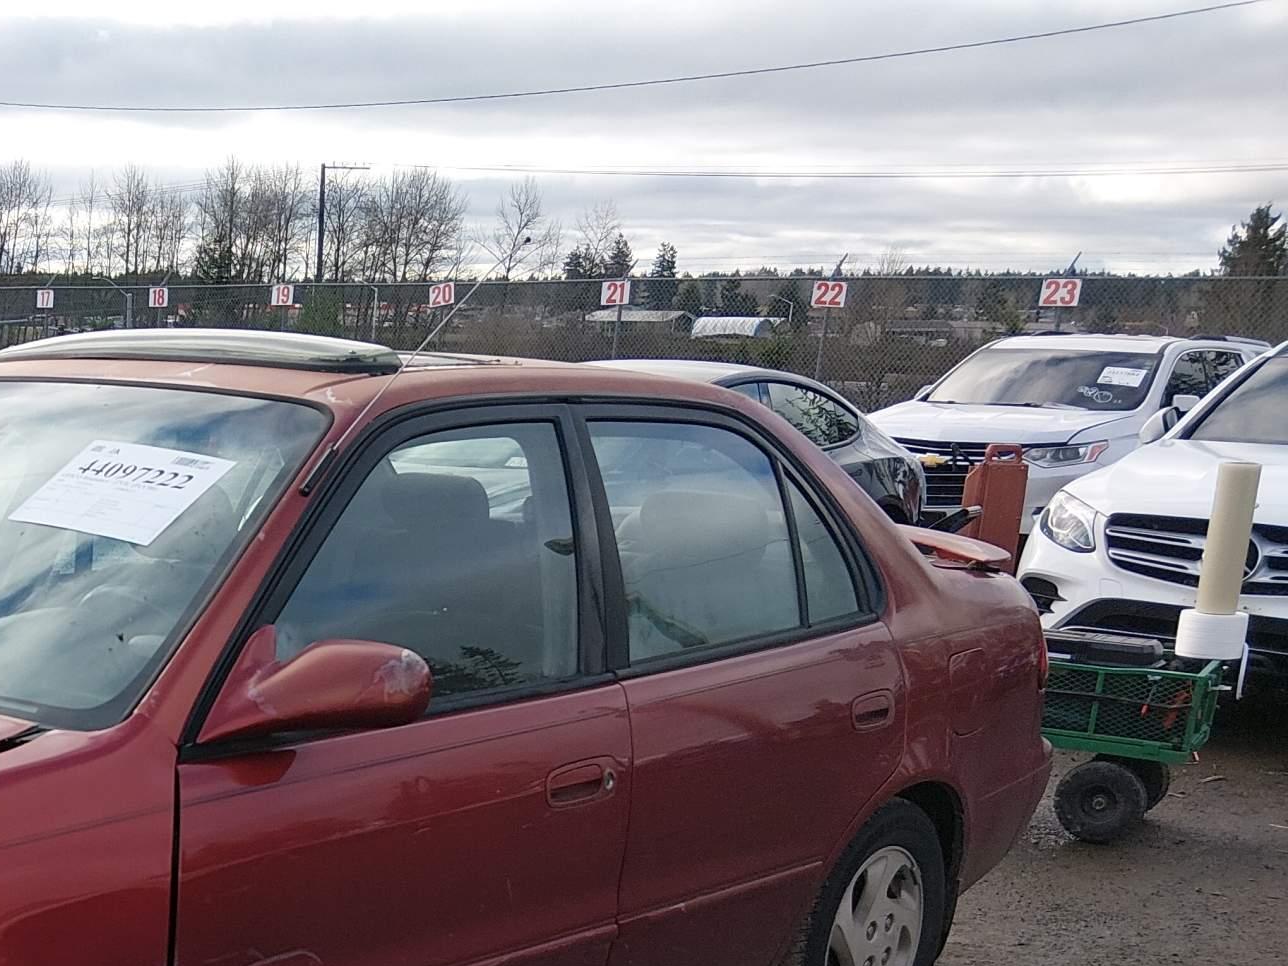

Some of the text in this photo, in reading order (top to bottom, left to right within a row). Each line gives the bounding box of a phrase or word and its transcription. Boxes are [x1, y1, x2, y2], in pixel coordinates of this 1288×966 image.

[40, 291, 51, 306] 17
[152, 288, 165, 306] 18
[275, 286, 290, 304] 19
[432, 284, 453, 305] 20
[606, 283, 625, 304] 21
[814, 281, 843, 306] 22
[1044, 281, 1077, 306] 23
[79, 459, 194, 490] 44097222
